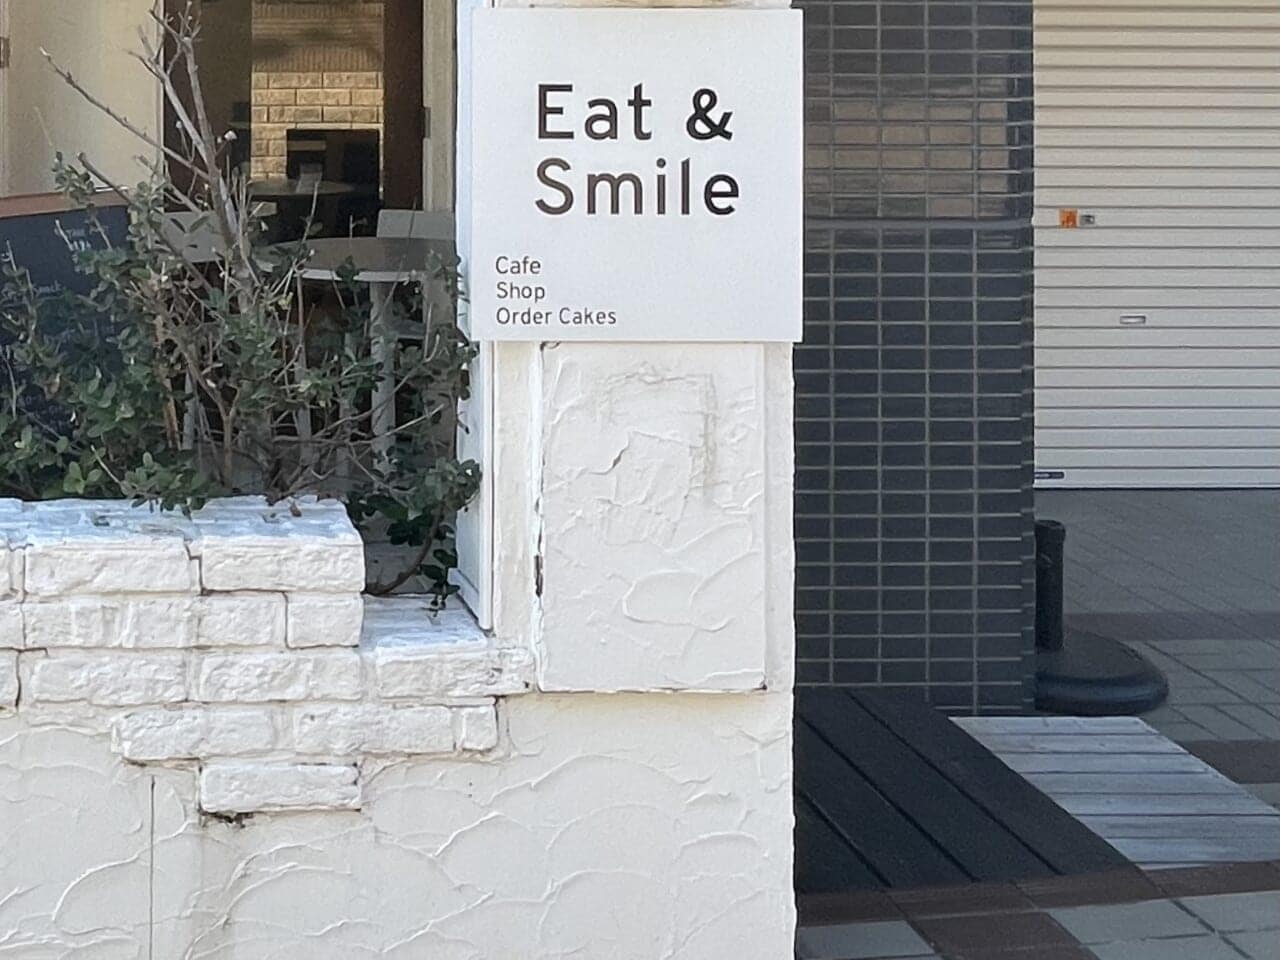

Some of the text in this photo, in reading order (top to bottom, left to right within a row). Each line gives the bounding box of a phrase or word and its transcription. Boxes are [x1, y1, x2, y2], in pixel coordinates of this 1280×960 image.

[537, 83, 733, 140] Eat &
[535, 157, 739, 215] Smile
[495, 255, 541, 274] Cafe
[496, 281, 545, 303] Shop
[496, 307, 617, 325] Order Cakes
